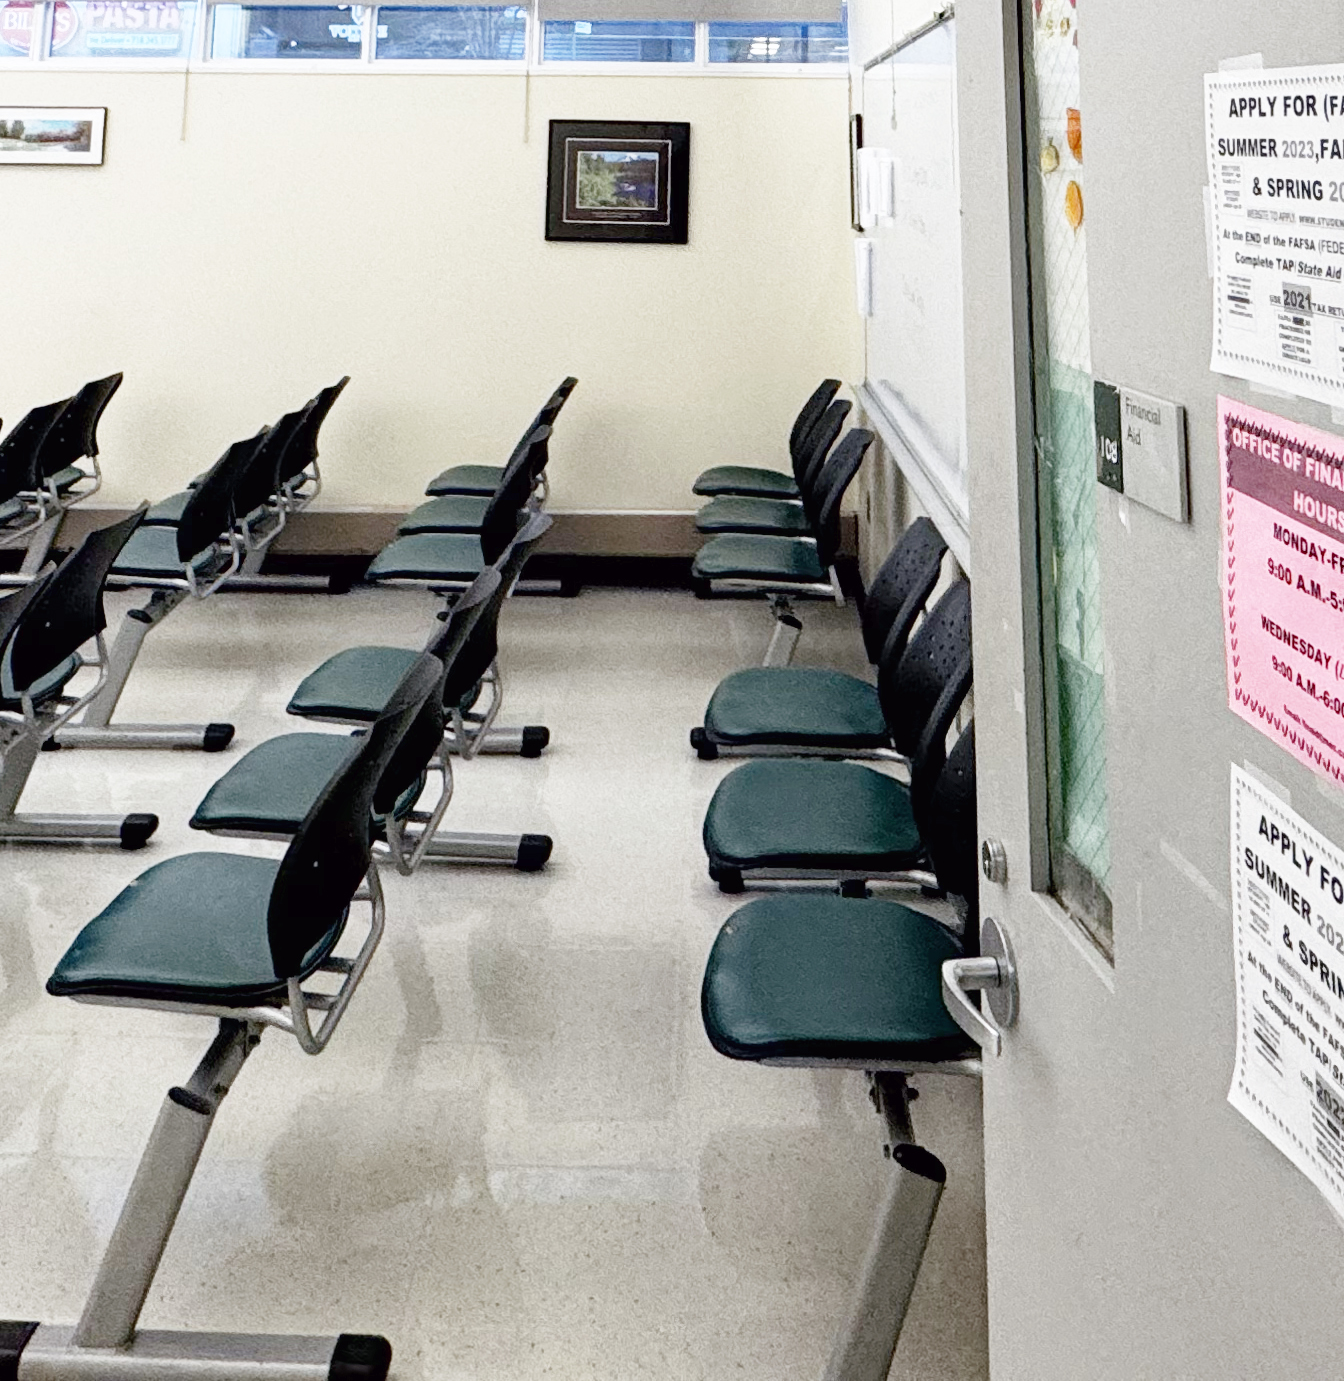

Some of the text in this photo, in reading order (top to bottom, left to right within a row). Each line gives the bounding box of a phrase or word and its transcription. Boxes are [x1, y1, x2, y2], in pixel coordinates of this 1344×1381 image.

[1229, 96, 1277, 118] APPLY
[1283, 95, 1317, 117] FOR
[1218, 138, 1278, 157] SUMMER
[1252, 176, 1262, 196] &
[1267, 178, 1324, 201] SPRING
[1223, 229, 1231, 239] At
[1232, 231, 1244, 241] the
[1245, 231, 1261, 245] END
[1263, 234, 1271, 245] of
[1272, 236, 1286, 247] the
[1288, 236, 1316, 251] FAFSA
[1235, 251, 1274, 270] Complete
[1326, 266, 1342, 280] Aid
[1125, 397, 1161, 425] Financial
[1127, 425, 1142, 446] Aid
[1232, 427, 1281, 464] OFFICE
[1282, 451, 1302, 472] OF
[1267, 557, 1293, 585] 9:00
[1261, 614, 1332, 670] WEDNESDAY
[1271, 654, 1293, 683] 9:00
[1258, 815, 1314, 877] APPLY
[1244, 847, 1312, 927] SUMMER
[1282, 924, 1293, 951] &
[1248, 950, 1257, 968] At
[1259, 961, 1272, 984] the
[1275, 976, 1293, 1004] END
[1306, 1009, 1320, 1033] the
[1262, 989, 1306, 1046] Complete
